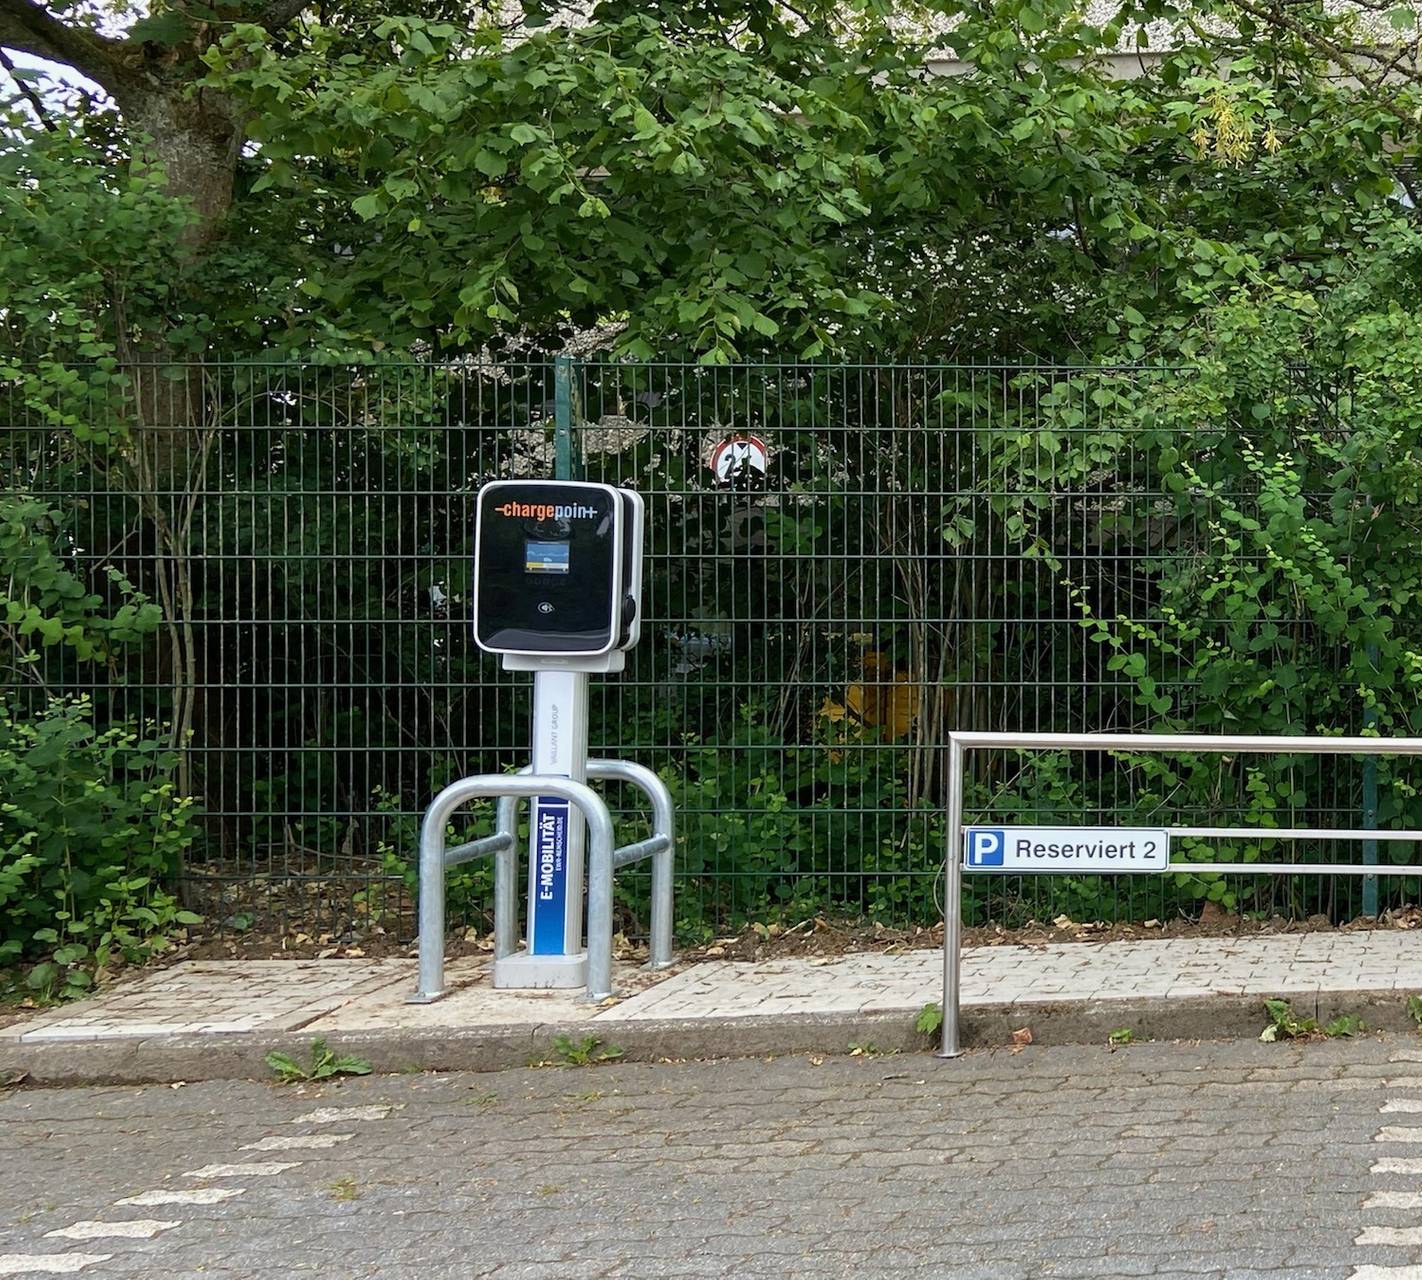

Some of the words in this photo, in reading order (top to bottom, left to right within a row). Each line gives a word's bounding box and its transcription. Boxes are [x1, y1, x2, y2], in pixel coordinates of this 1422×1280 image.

[551, 704, 560, 730] GROUP
[540, 813, 556, 900] E-MOBILITÄT
[974, 833, 998, 864] P
[1016, 839, 1136, 858] Reserviert
[1143, 841, 1157, 858] 2
